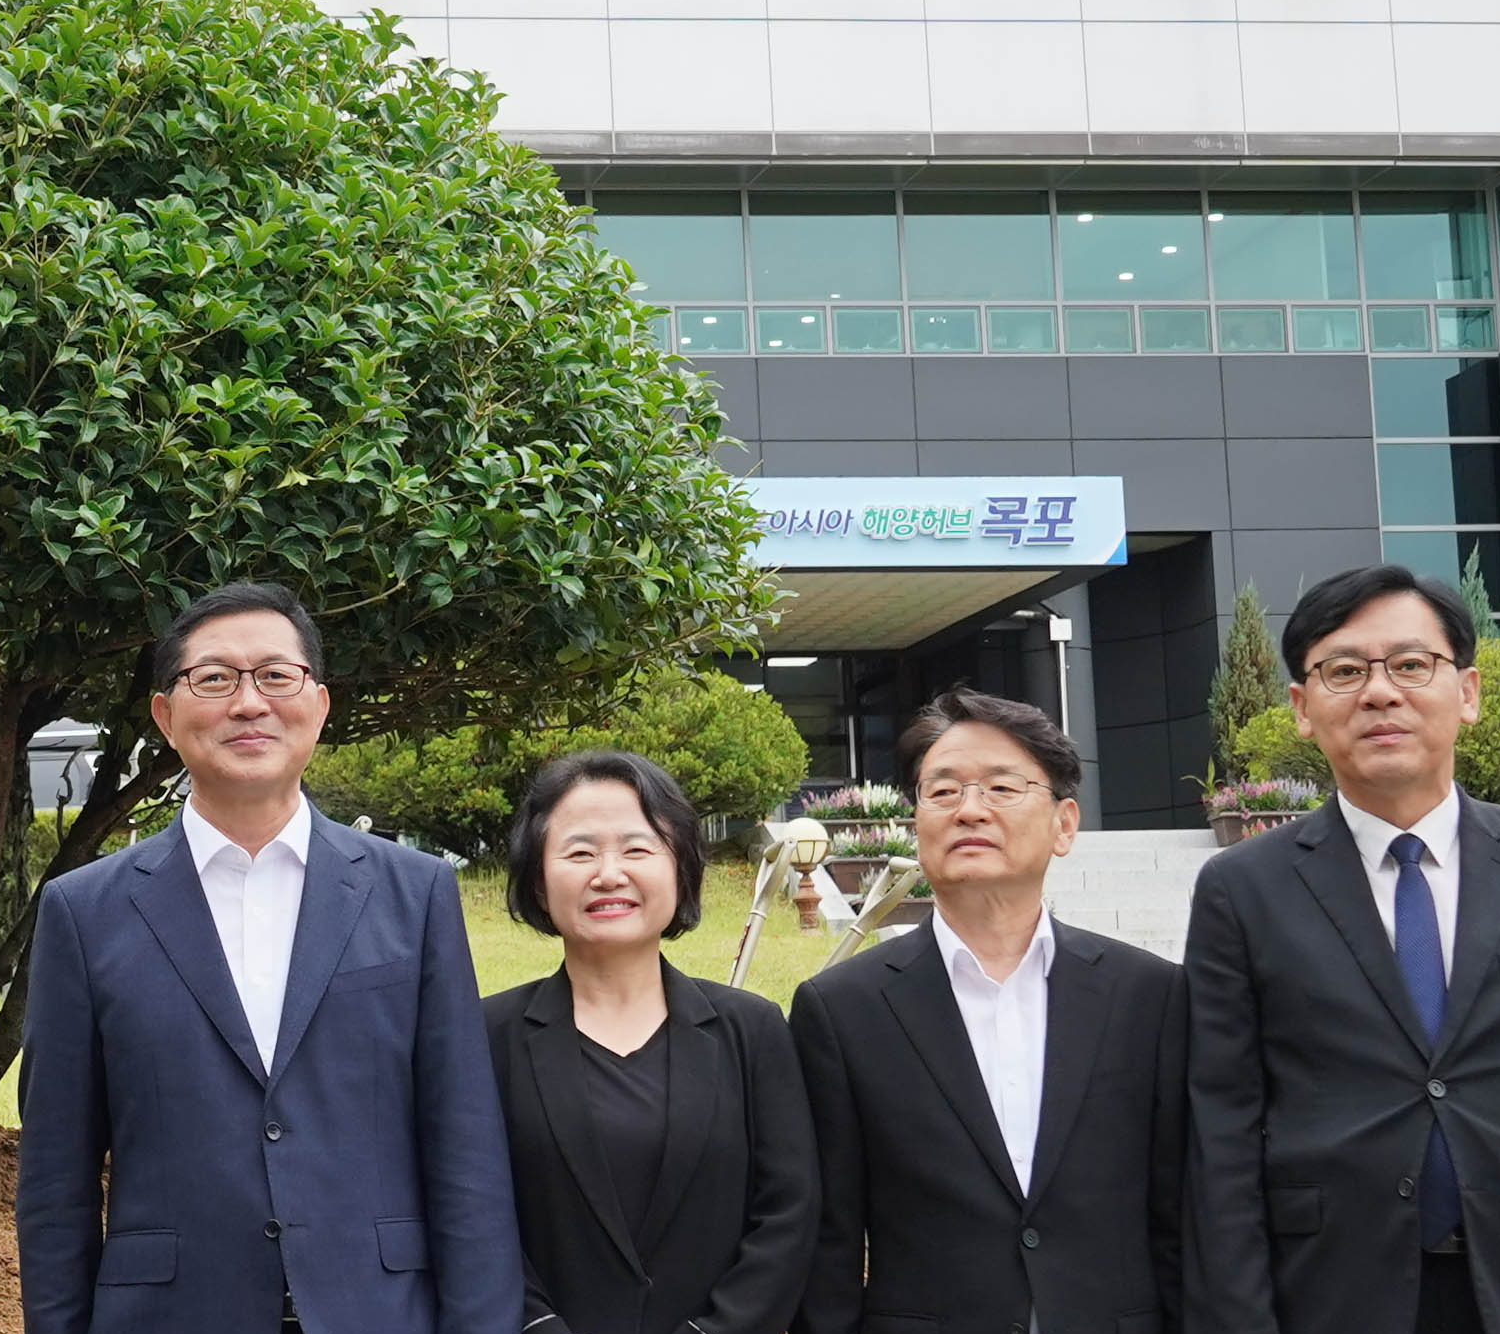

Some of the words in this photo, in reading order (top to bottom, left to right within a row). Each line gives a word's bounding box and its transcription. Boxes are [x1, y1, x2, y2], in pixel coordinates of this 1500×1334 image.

[754, 508, 854, 536] 아시아
[862, 507, 972, 536] 해양허브
[981, 496, 1078, 546] 목포
